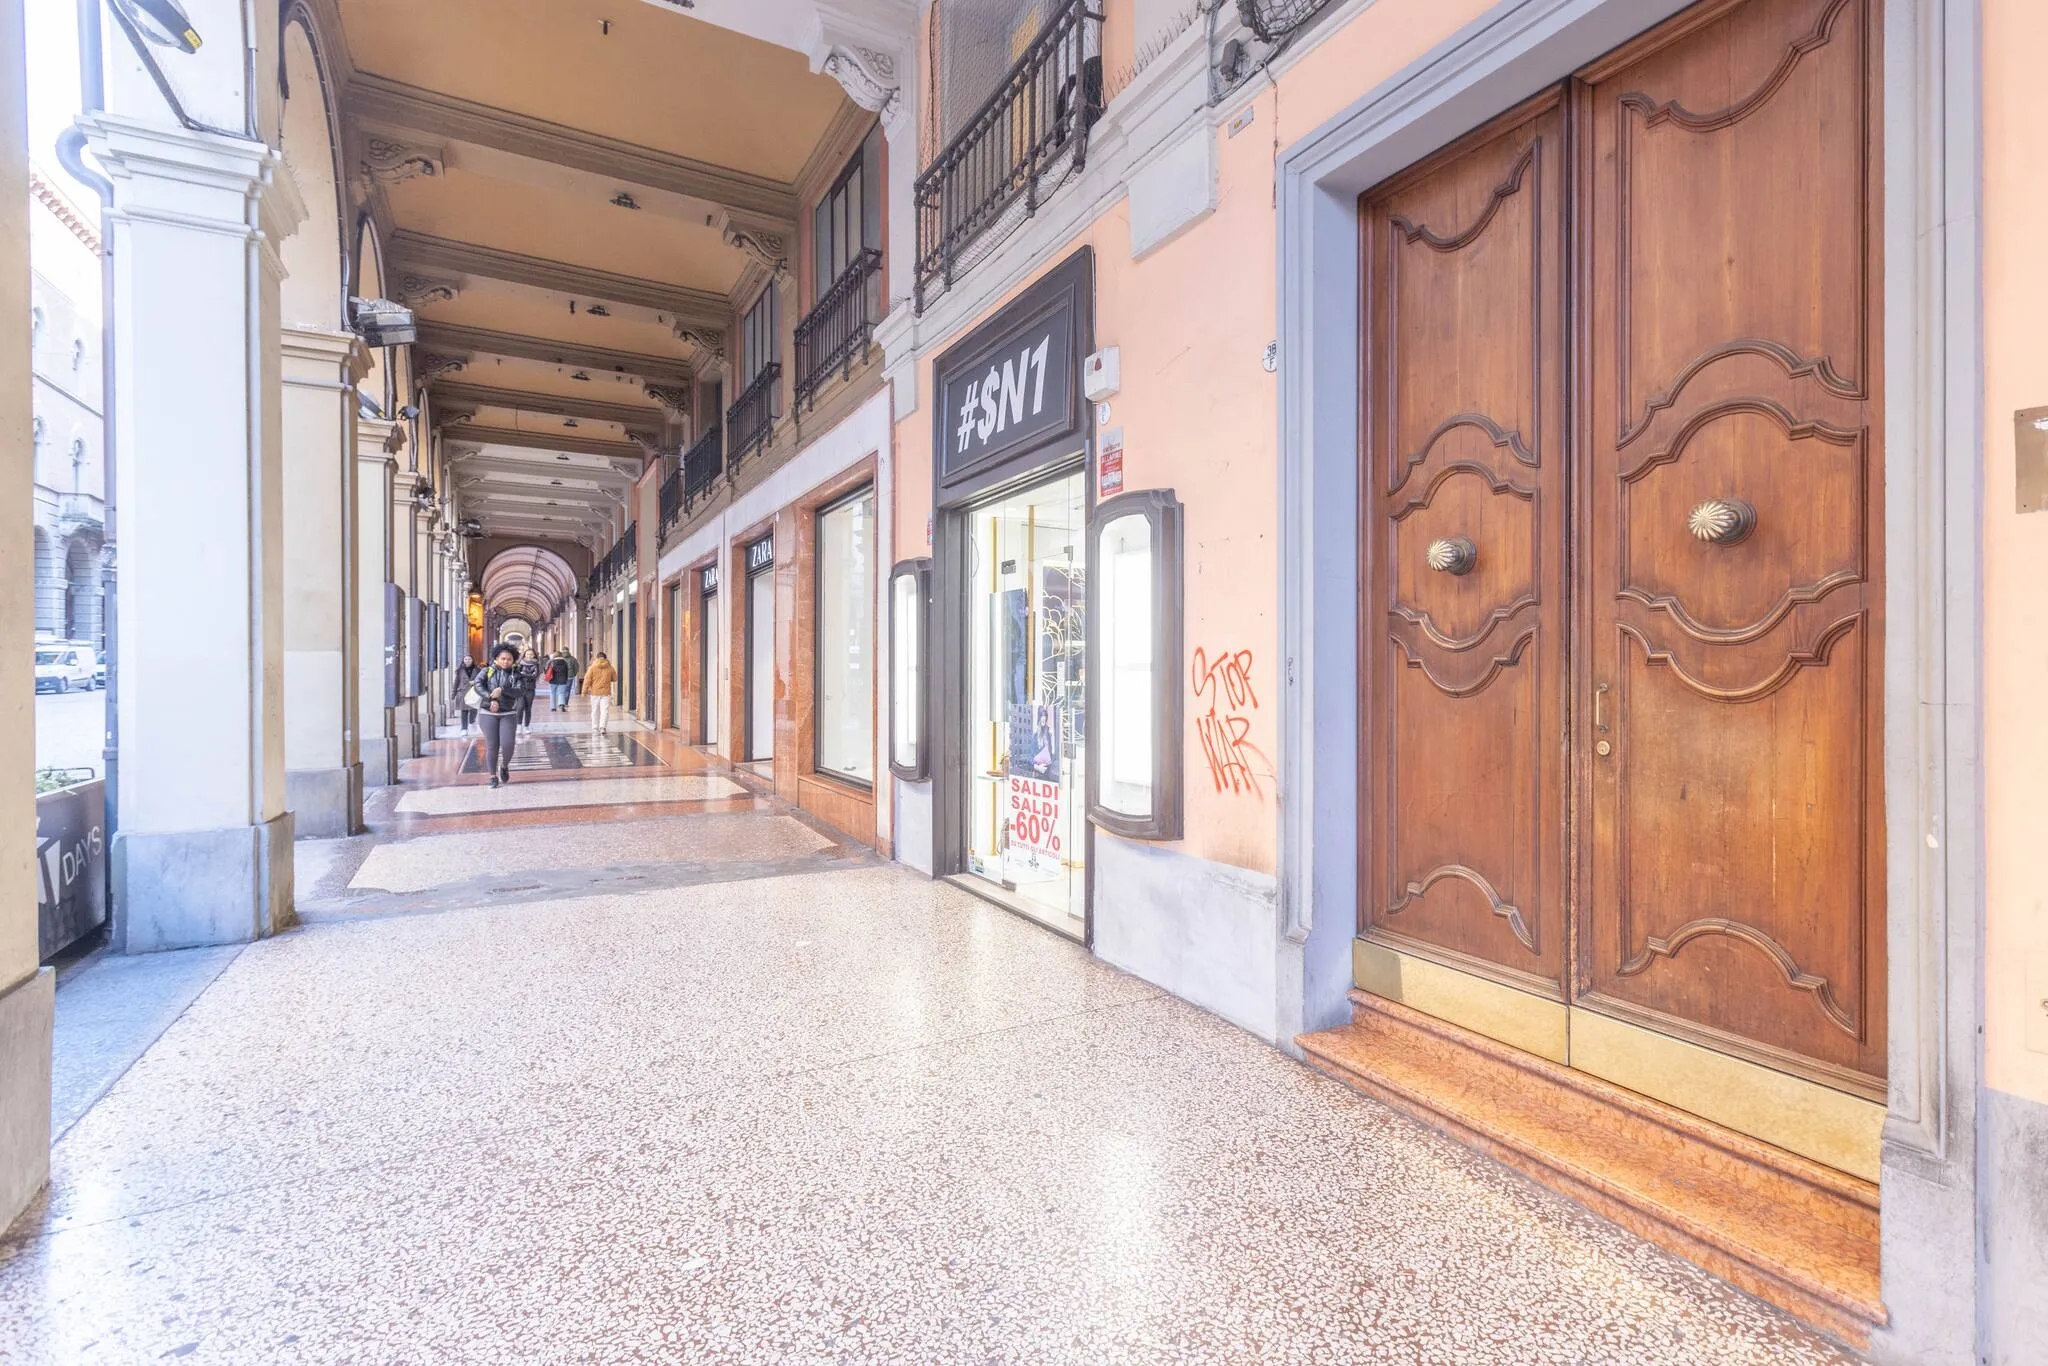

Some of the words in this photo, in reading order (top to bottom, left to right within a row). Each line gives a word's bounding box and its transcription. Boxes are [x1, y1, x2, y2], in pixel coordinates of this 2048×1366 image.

[957, 334, 1050, 453] #$N1
[752, 539, 773, 567] ZARA
[1193, 647, 1258, 716] STOP
[1197, 714, 1273, 804] WAR
[1011, 778, 1059, 800] SALDI
[1011, 795, 1059, 819] SALDI
[62, 825, 102, 886] DAYS
[1010, 811, 1060, 851] -60%
